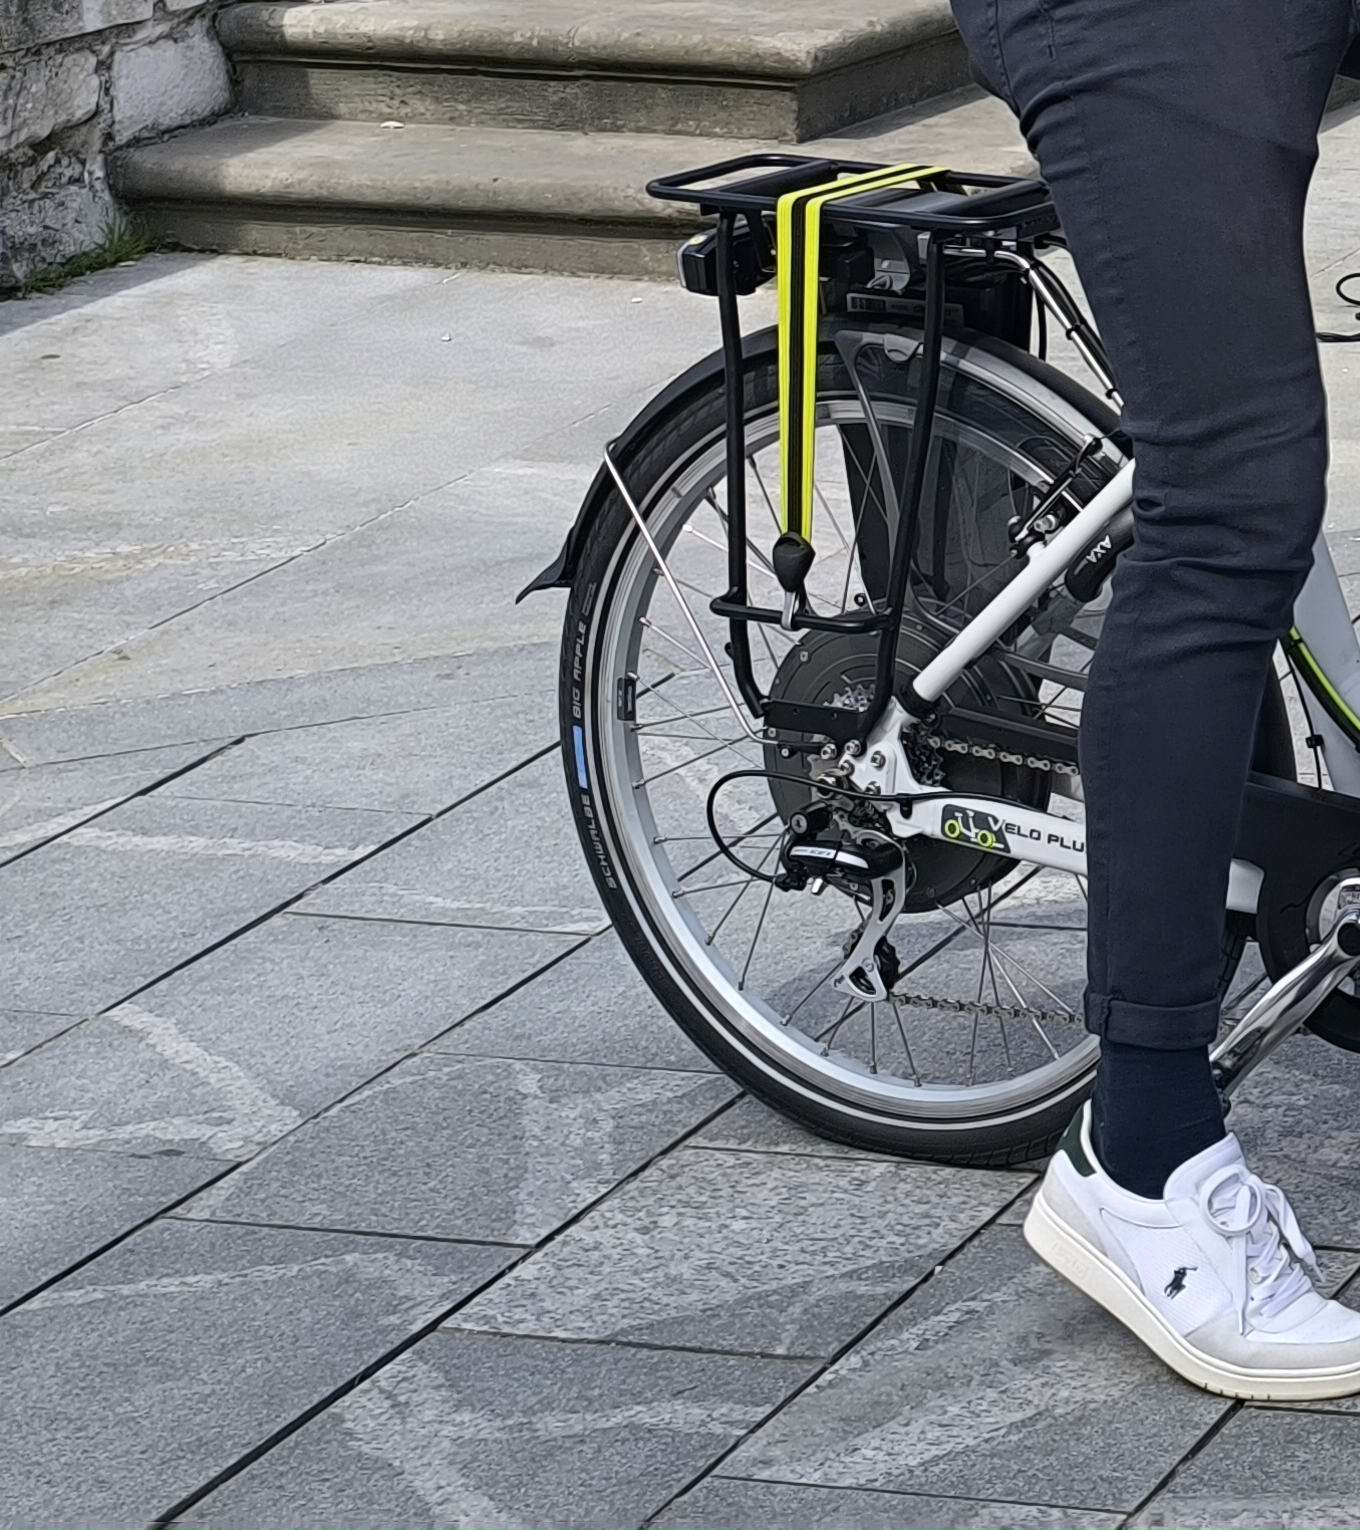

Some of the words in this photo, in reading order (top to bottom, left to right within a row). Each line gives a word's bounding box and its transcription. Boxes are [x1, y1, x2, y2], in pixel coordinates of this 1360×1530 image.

[1086, 534, 1112, 563] AXA
[573, 622, 587, 683] APPLE
[572, 687, 581, 719] BIG
[580, 794, 618, 889] SCHWALBE
[988, 816, 1042, 841] VELO
